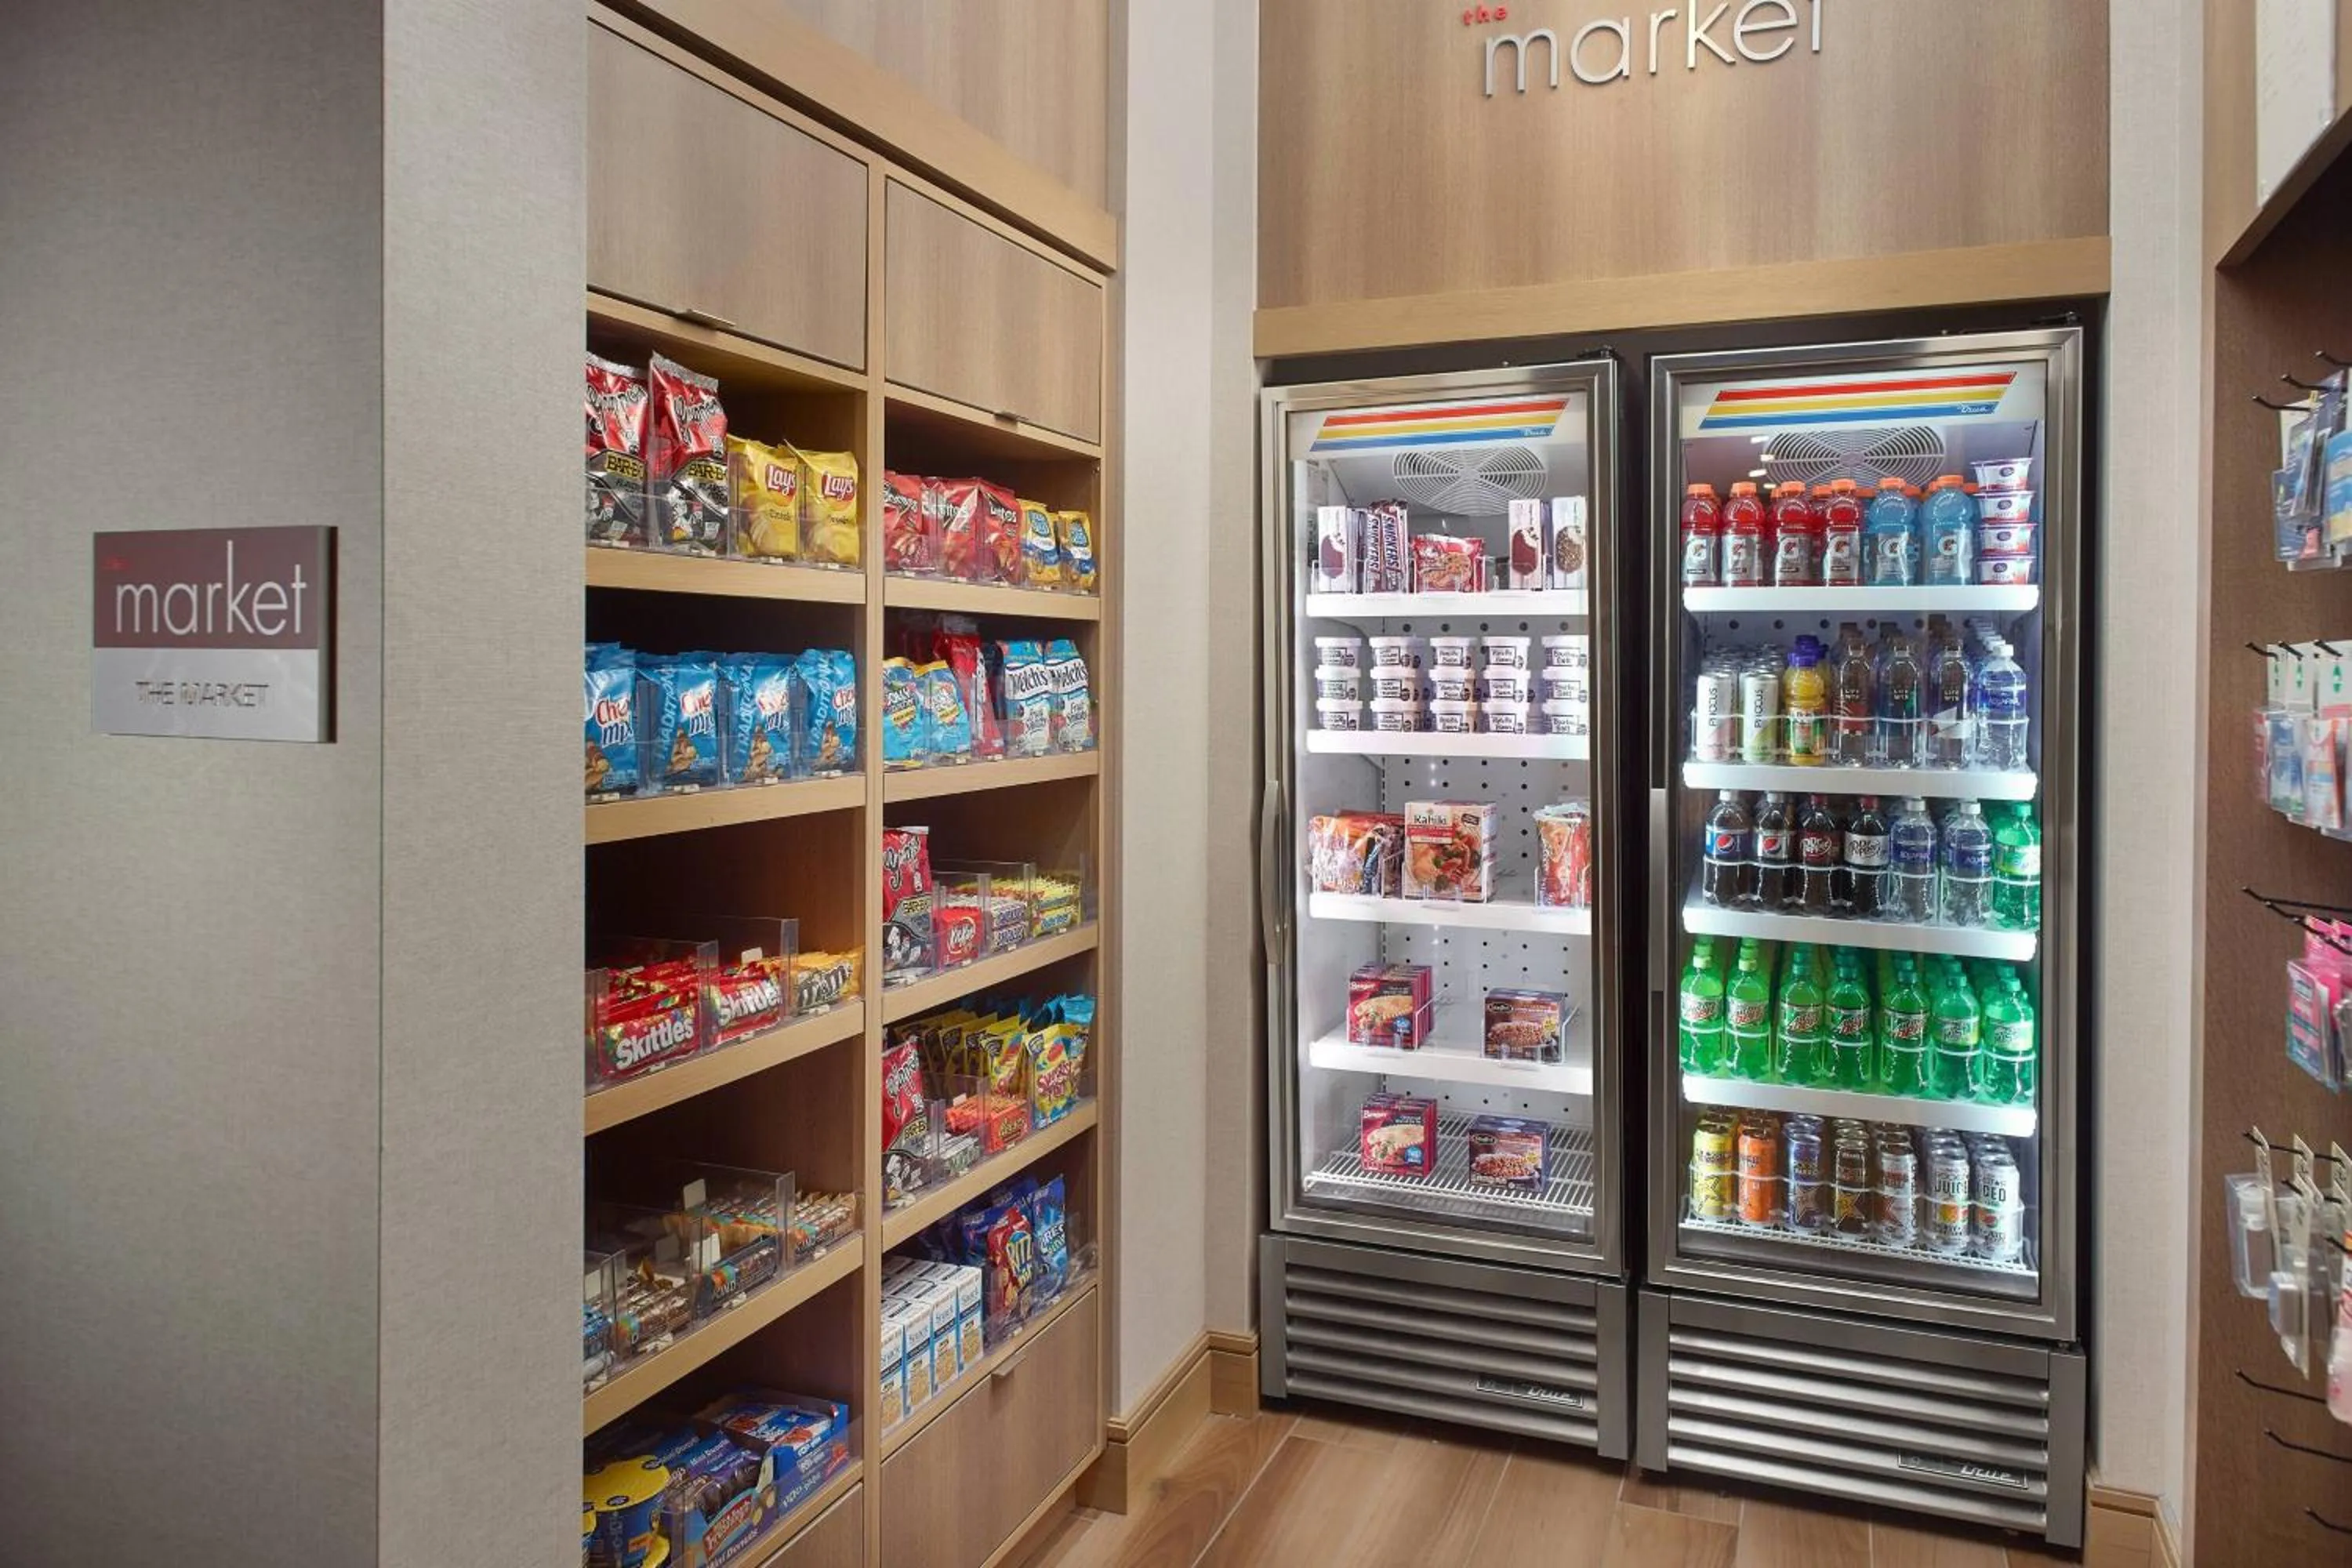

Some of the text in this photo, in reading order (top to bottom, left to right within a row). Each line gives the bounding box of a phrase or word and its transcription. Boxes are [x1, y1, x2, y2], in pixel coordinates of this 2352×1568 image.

[1463, 5, 1508, 25] the
[115, 539, 307, 636] market
[136, 681, 269, 706] THE MARKET
[681, 690, 713, 716] Che
[833, 688, 855, 709] Che
[596, 697, 630, 724] Che
[616, 1019, 694, 1071] Skittles
